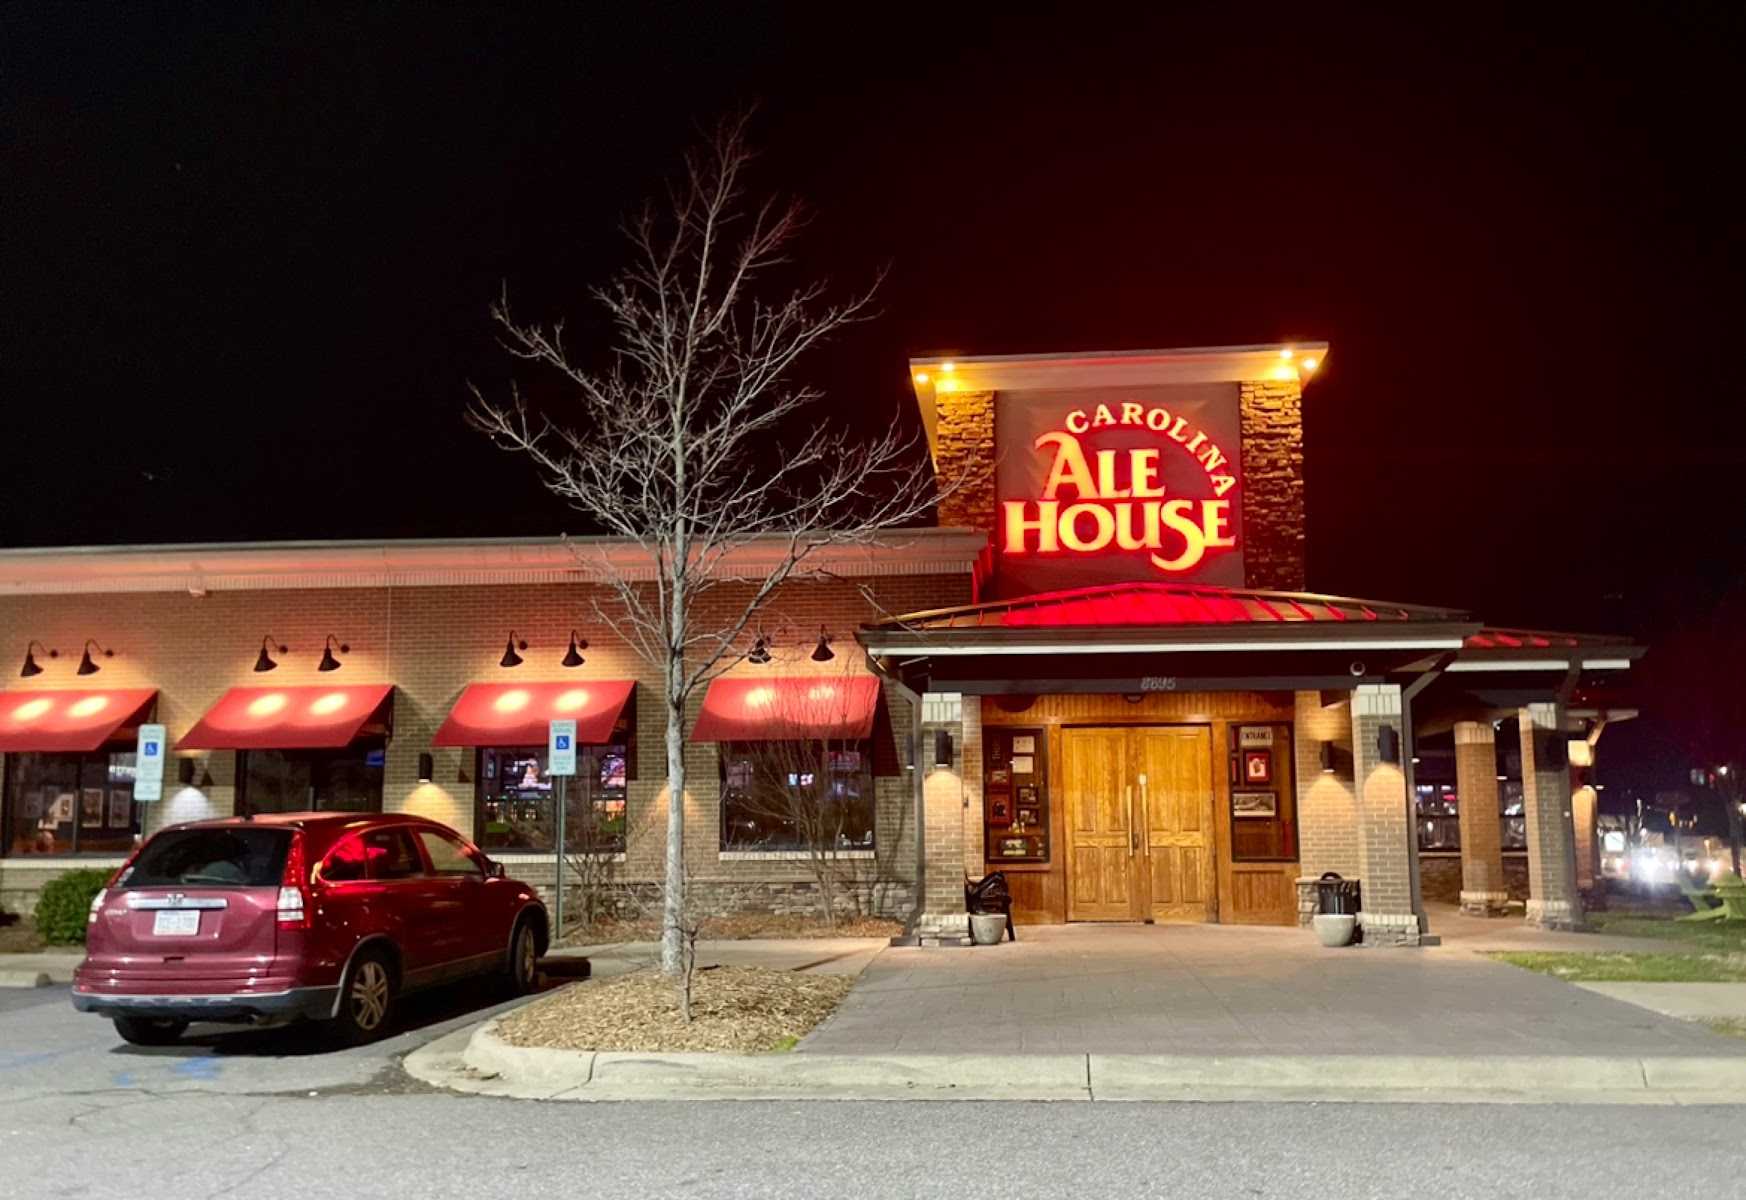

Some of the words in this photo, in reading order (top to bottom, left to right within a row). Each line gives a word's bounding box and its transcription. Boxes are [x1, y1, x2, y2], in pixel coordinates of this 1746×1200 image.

[1035, 431, 1167, 500] ALE
[1066, 402, 1236, 497] CAROLINA
[1003, 499, 1236, 571] HOUSE
